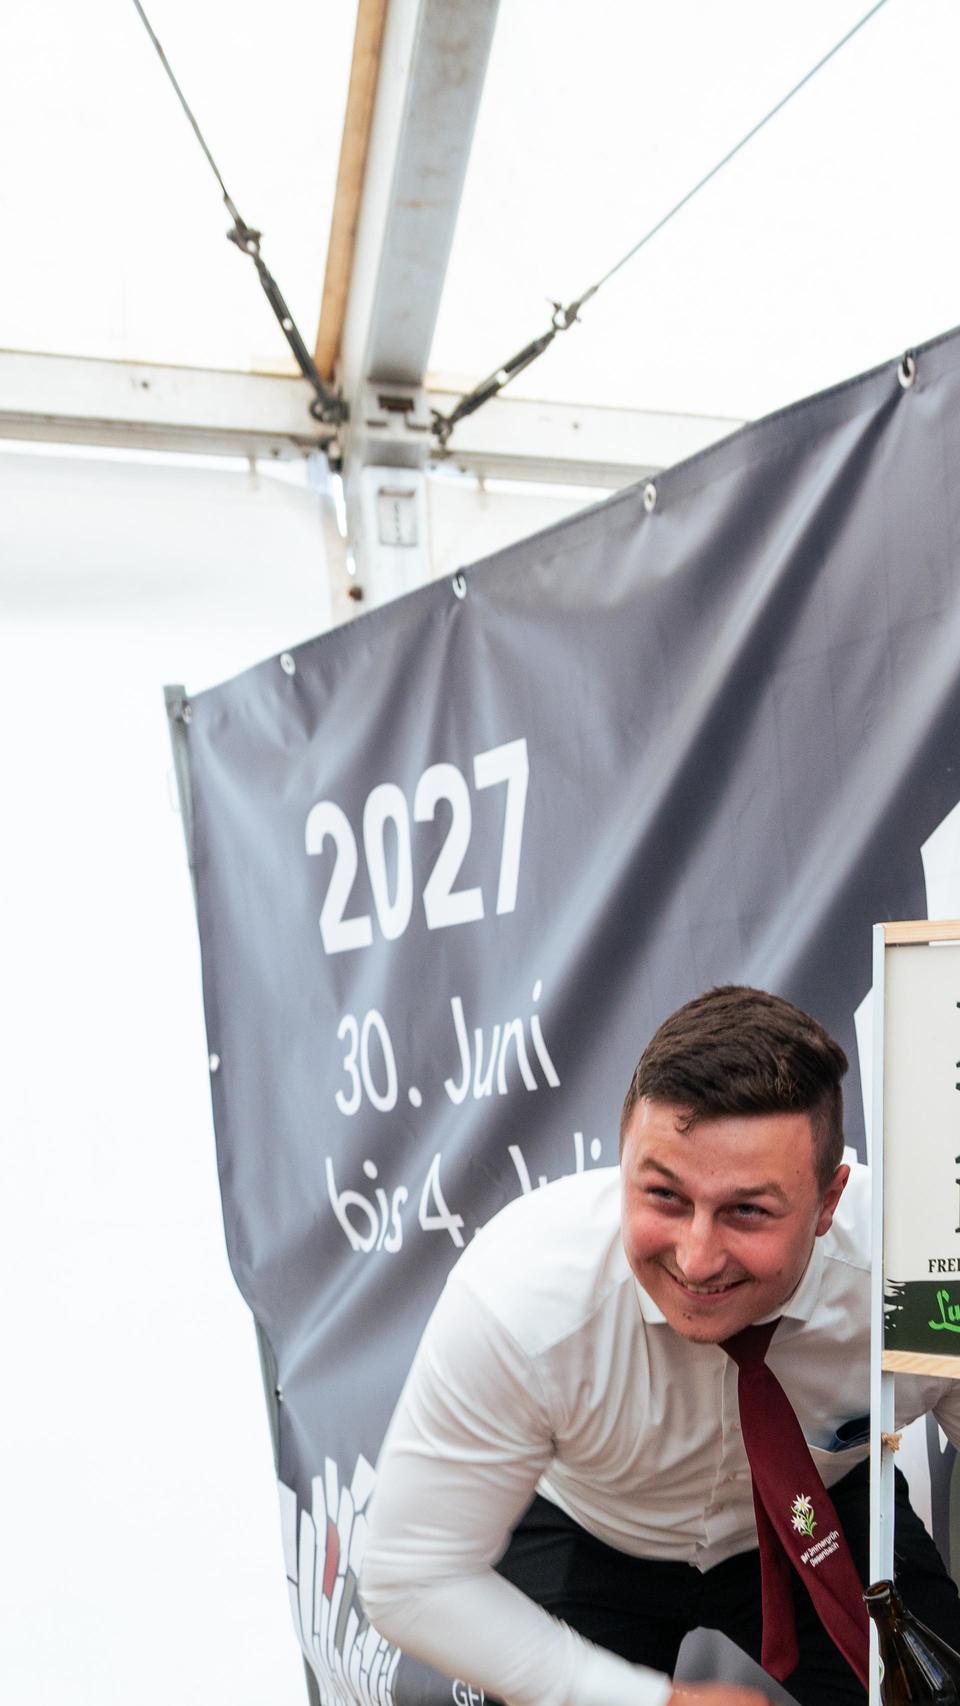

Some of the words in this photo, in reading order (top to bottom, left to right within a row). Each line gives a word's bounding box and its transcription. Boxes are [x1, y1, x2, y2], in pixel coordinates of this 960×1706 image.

[305, 738, 529, 954] 2027
[335, 1009, 422, 1115] 30.
[444, 980, 560, 1105] Juni
[325, 1156, 408, 1253] bis
[418, 1153, 482, 1248] 4
